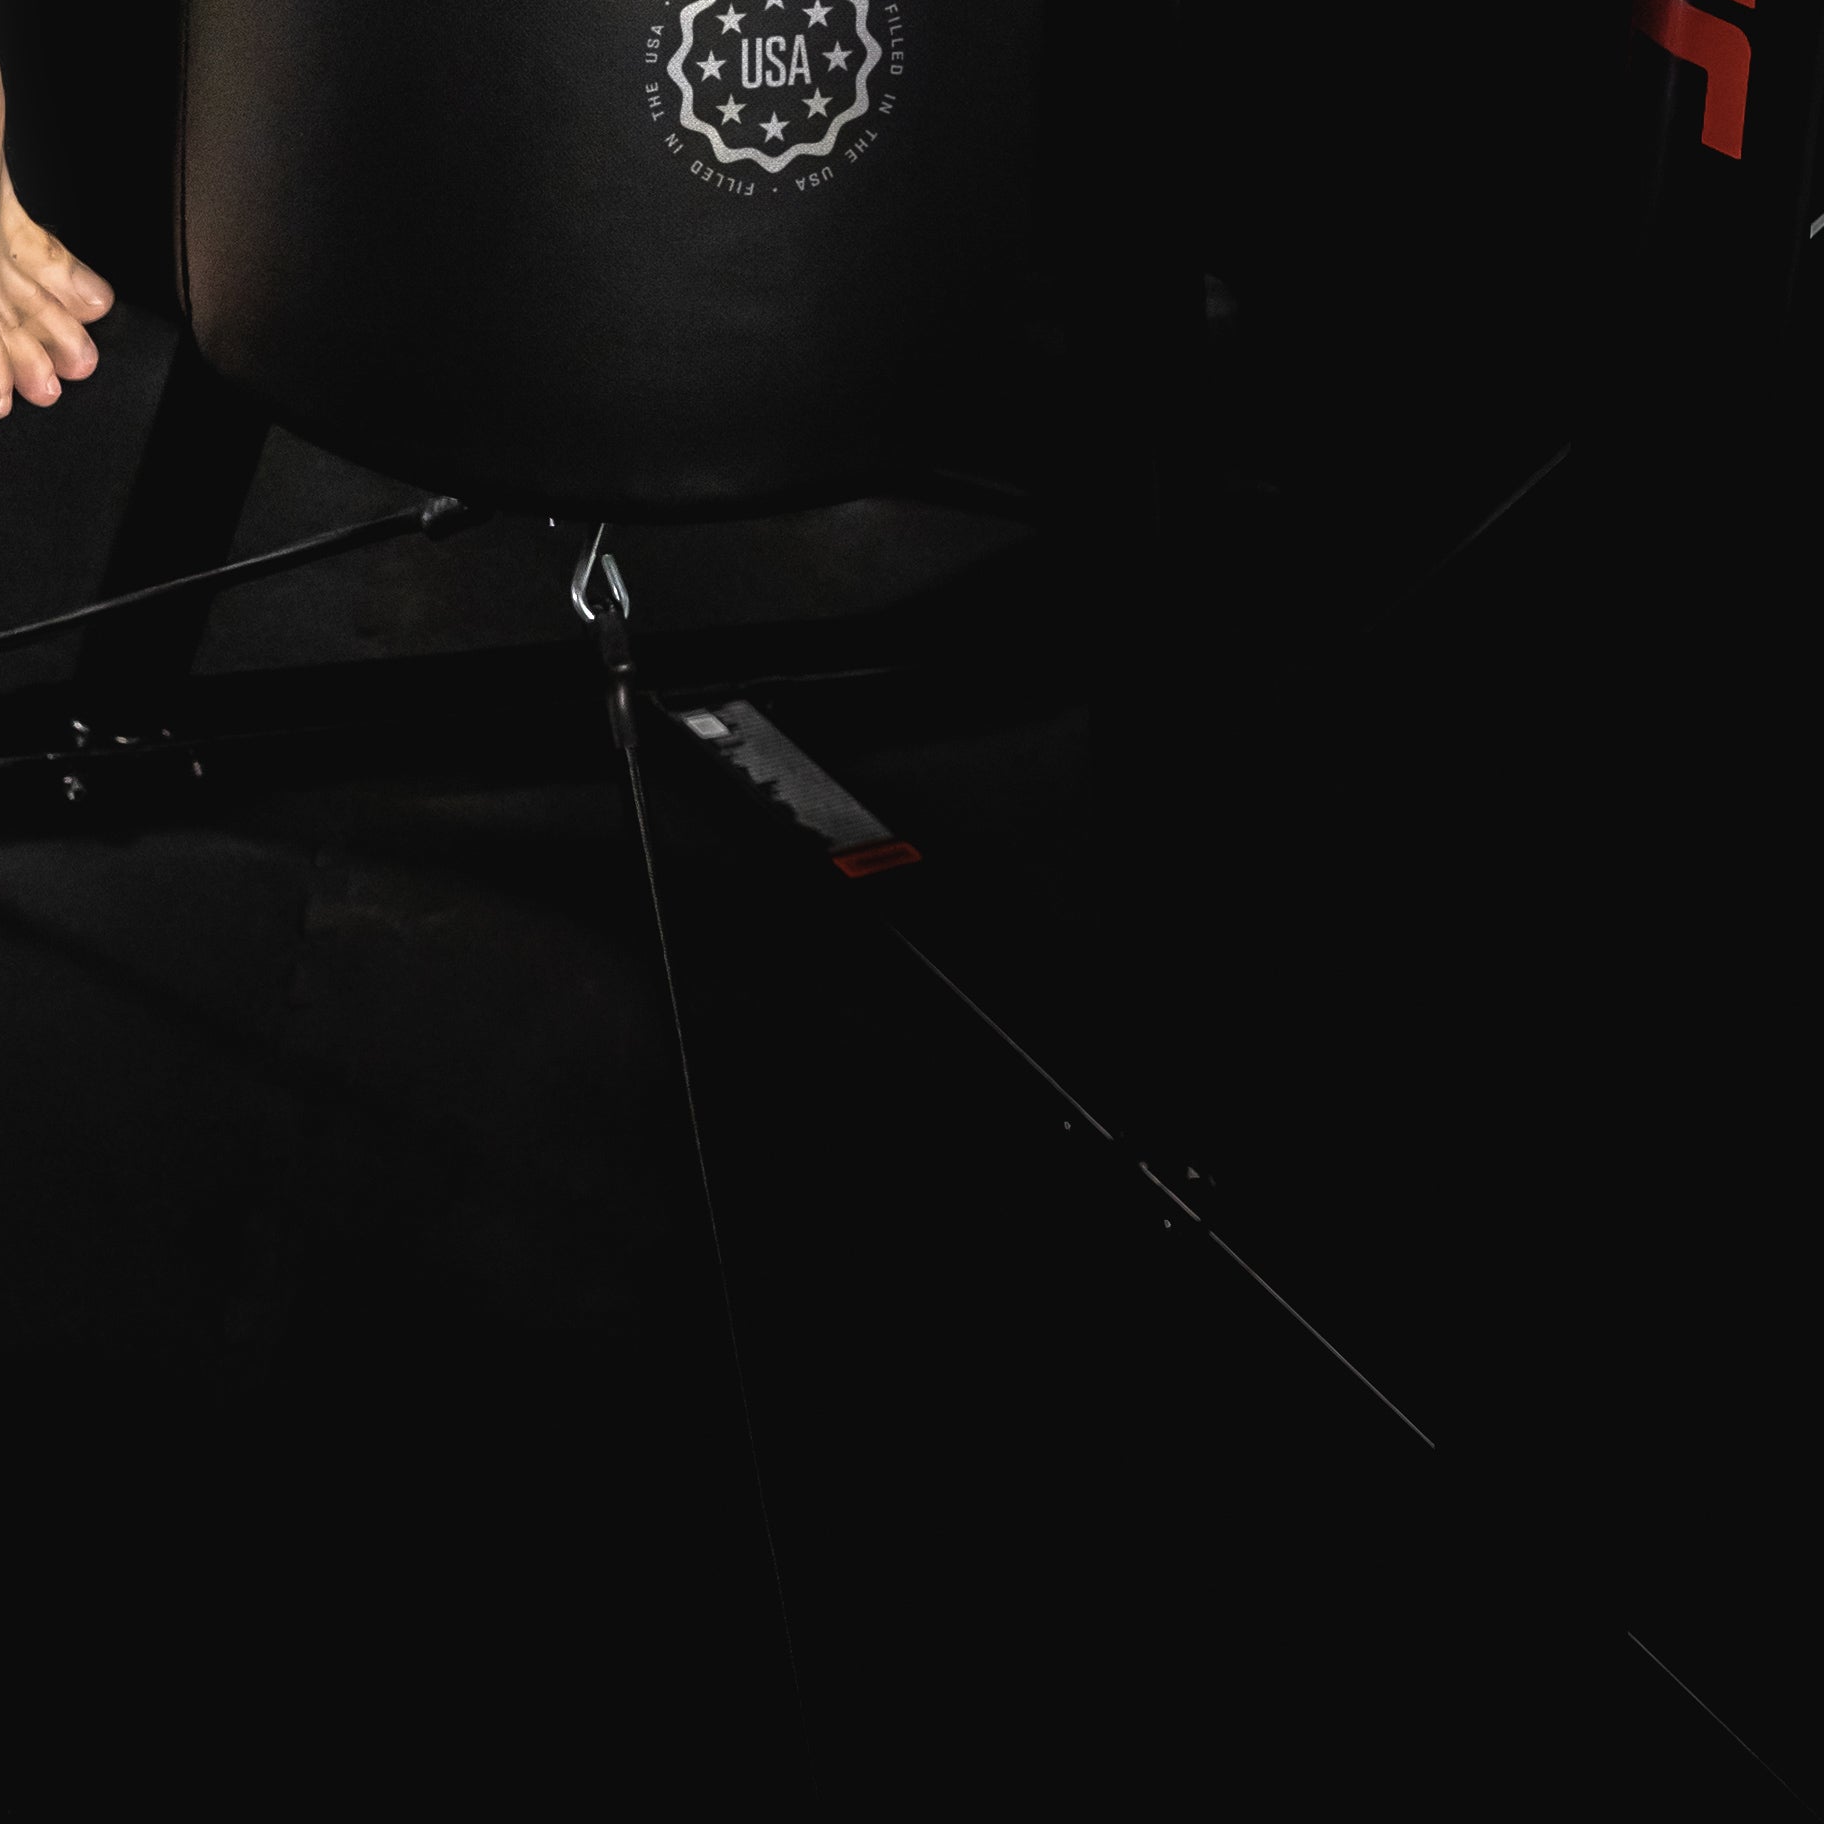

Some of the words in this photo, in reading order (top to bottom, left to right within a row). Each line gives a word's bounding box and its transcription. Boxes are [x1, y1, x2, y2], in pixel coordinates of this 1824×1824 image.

[644, 23, 666, 64] USA
[884, 3, 904, 77] FILLED
[740, 33, 812, 90] USA
[644, 81, 664, 123] THE
[878, 92, 896, 114] IN
[664, 132, 685, 155] IN
[844, 128, 879, 164] THE
[689, 159, 756, 196] FILLED
[794, 166, 835, 192] USA
